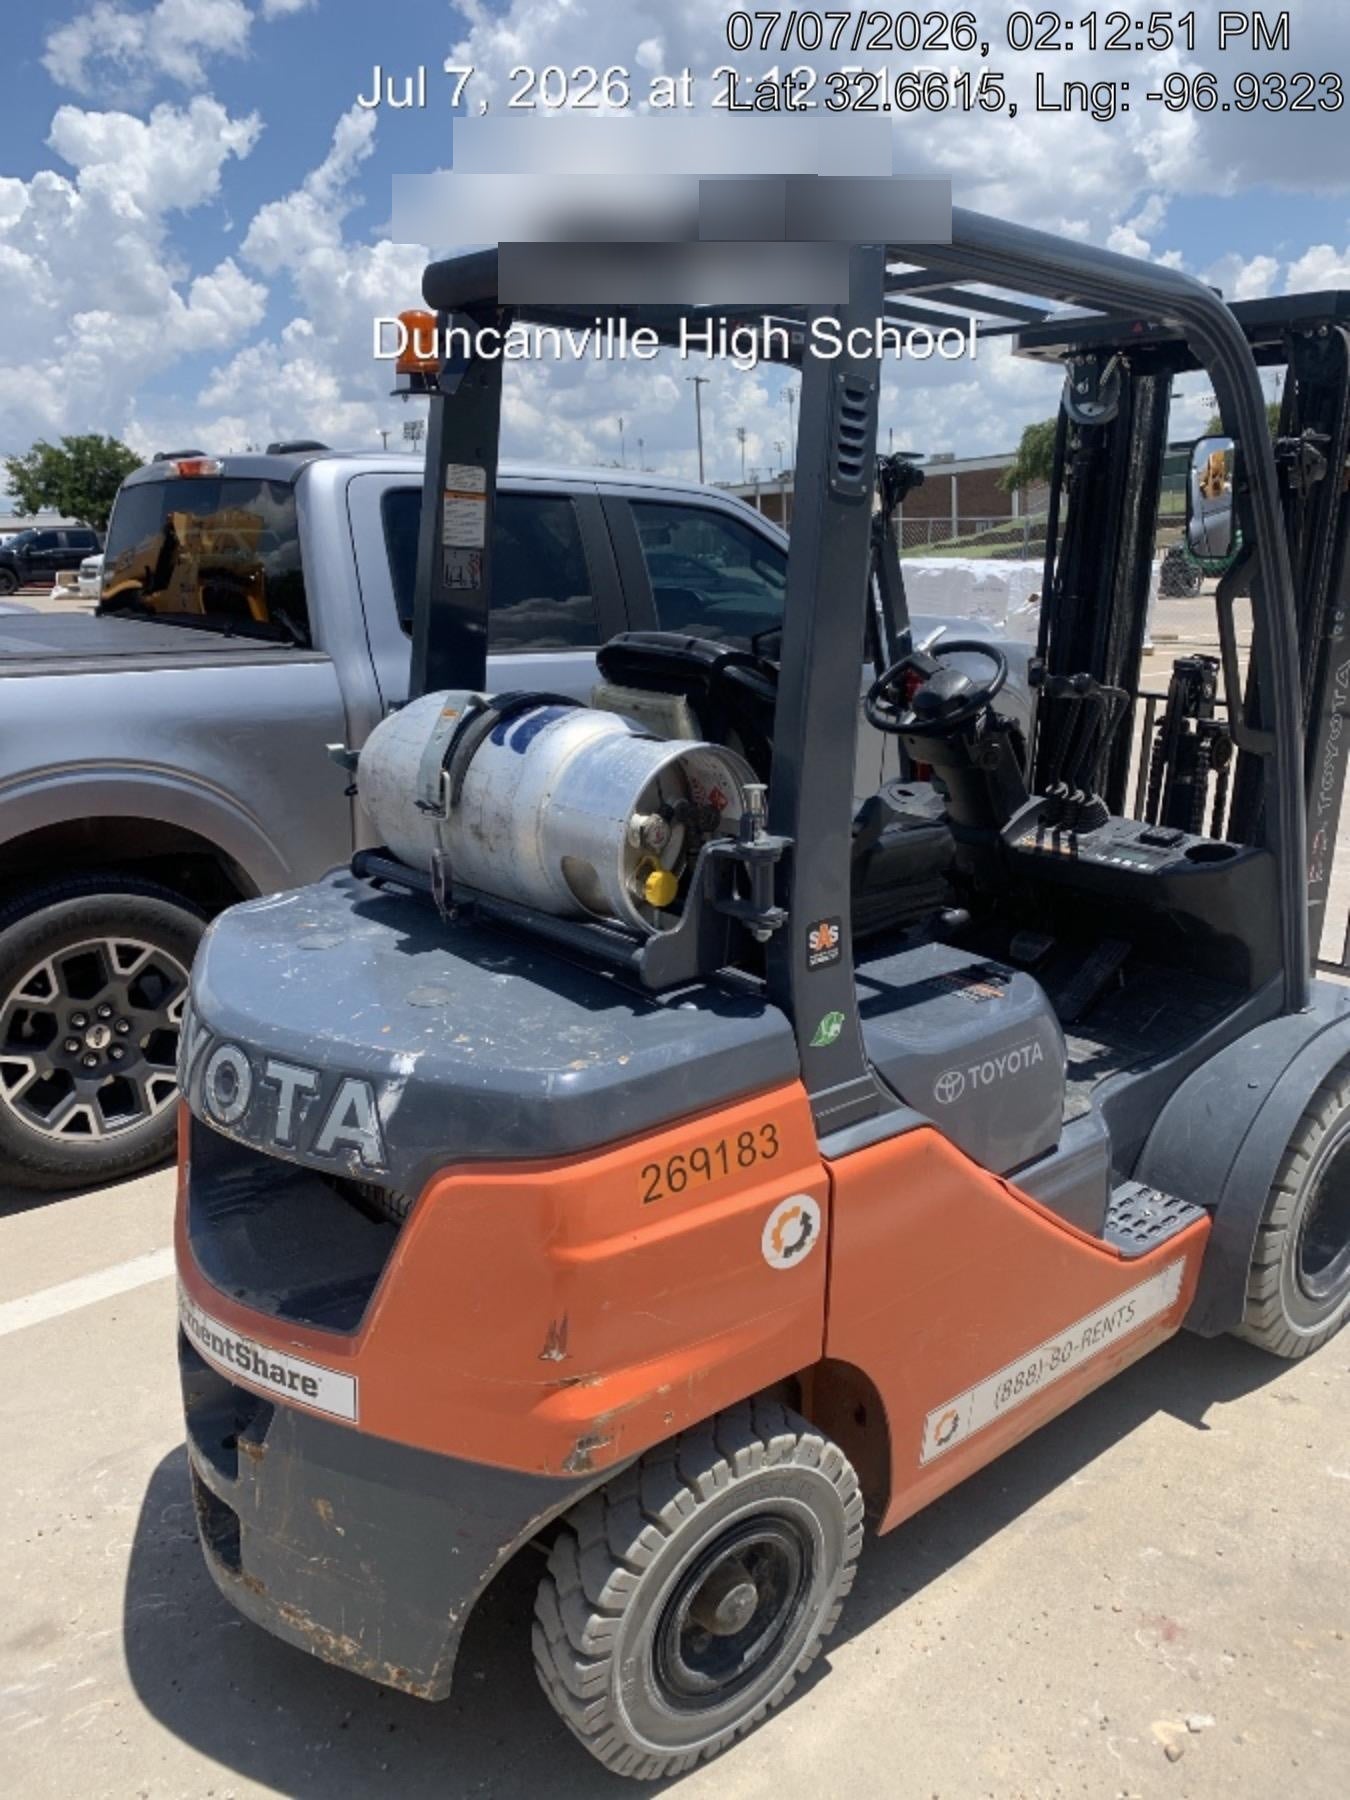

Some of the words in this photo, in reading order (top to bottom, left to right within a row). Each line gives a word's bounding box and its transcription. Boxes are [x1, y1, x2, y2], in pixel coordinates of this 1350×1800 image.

[968, 1042, 1043, 1088] TOYOTA
[641, 1123, 779, 1204] 269183
[994, 1300, 1136, 1410] (888)-80-RENTS
